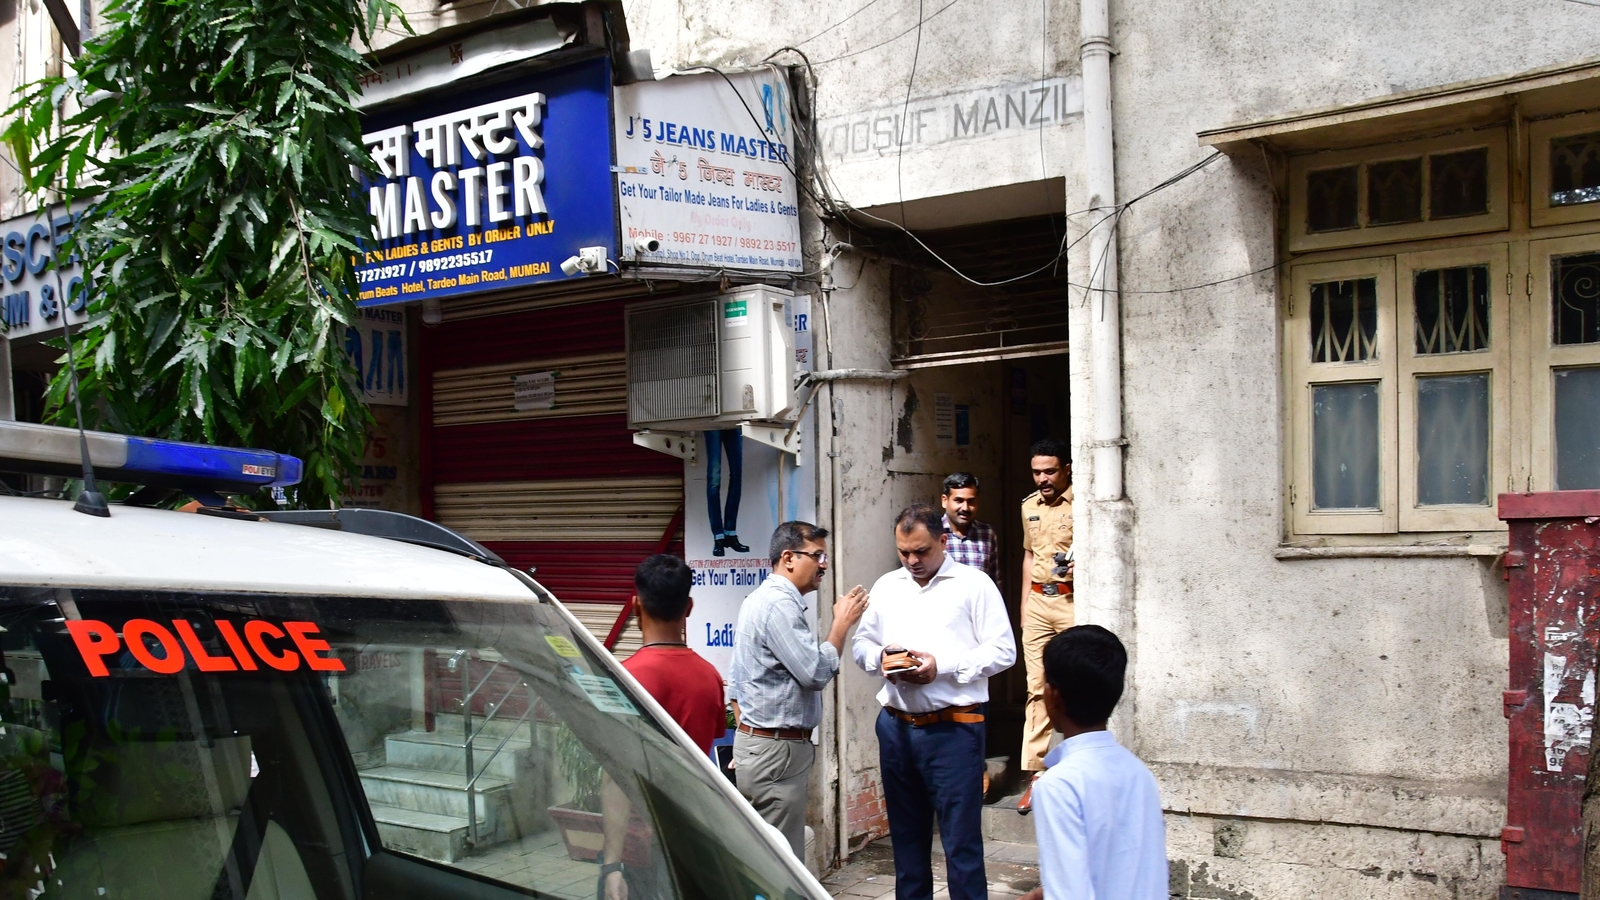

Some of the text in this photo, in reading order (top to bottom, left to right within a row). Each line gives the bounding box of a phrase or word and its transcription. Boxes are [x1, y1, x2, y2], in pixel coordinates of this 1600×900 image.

[953, 83, 1084, 138] MANZIL
[413, 92, 546, 169] मास्टर
[656, 121, 716, 151] JEANS
[720, 133, 788, 164] MASTER
[369, 156, 548, 241] MASTER
[620, 181, 797, 217] Get Your Tailor Made Jeans For Ladies & Gents
[385, 244, 419, 261] LADIES
[421, 242, 429, 254] &
[431, 236, 463, 252] GENTS
[468, 233, 482, 247] BY
[485, 225, 521, 243] ORDER
[526, 220, 555, 237] ONLY
[628, 226, 664, 242] Mobile
[673, 231, 696, 244] 9967
[698, 234, 710, 245] 27
[711, 235, 732, 247] 1927
[740, 238, 761, 249] 9892
[764, 240, 774, 250] 23
[776, 241, 796, 252] 5517
[705, 213, 729, 227] Order
[732, 216, 751, 232] Only
[356, 261, 551, 300] rum Beats Hotel, Tardeo Main Road, MUMBAI
[409, 260, 416, 277] /
[418, 249, 493, 273] 9892235517
[39, 284, 58, 319] &
[365, 308, 403, 324] MASTER
[691, 569, 706, 586] Get
[708, 569, 728, 586] Your
[730, 568, 757, 586] Tailor
[66, 619, 346, 678] POLICE
[706, 622, 736, 647] Ladi
